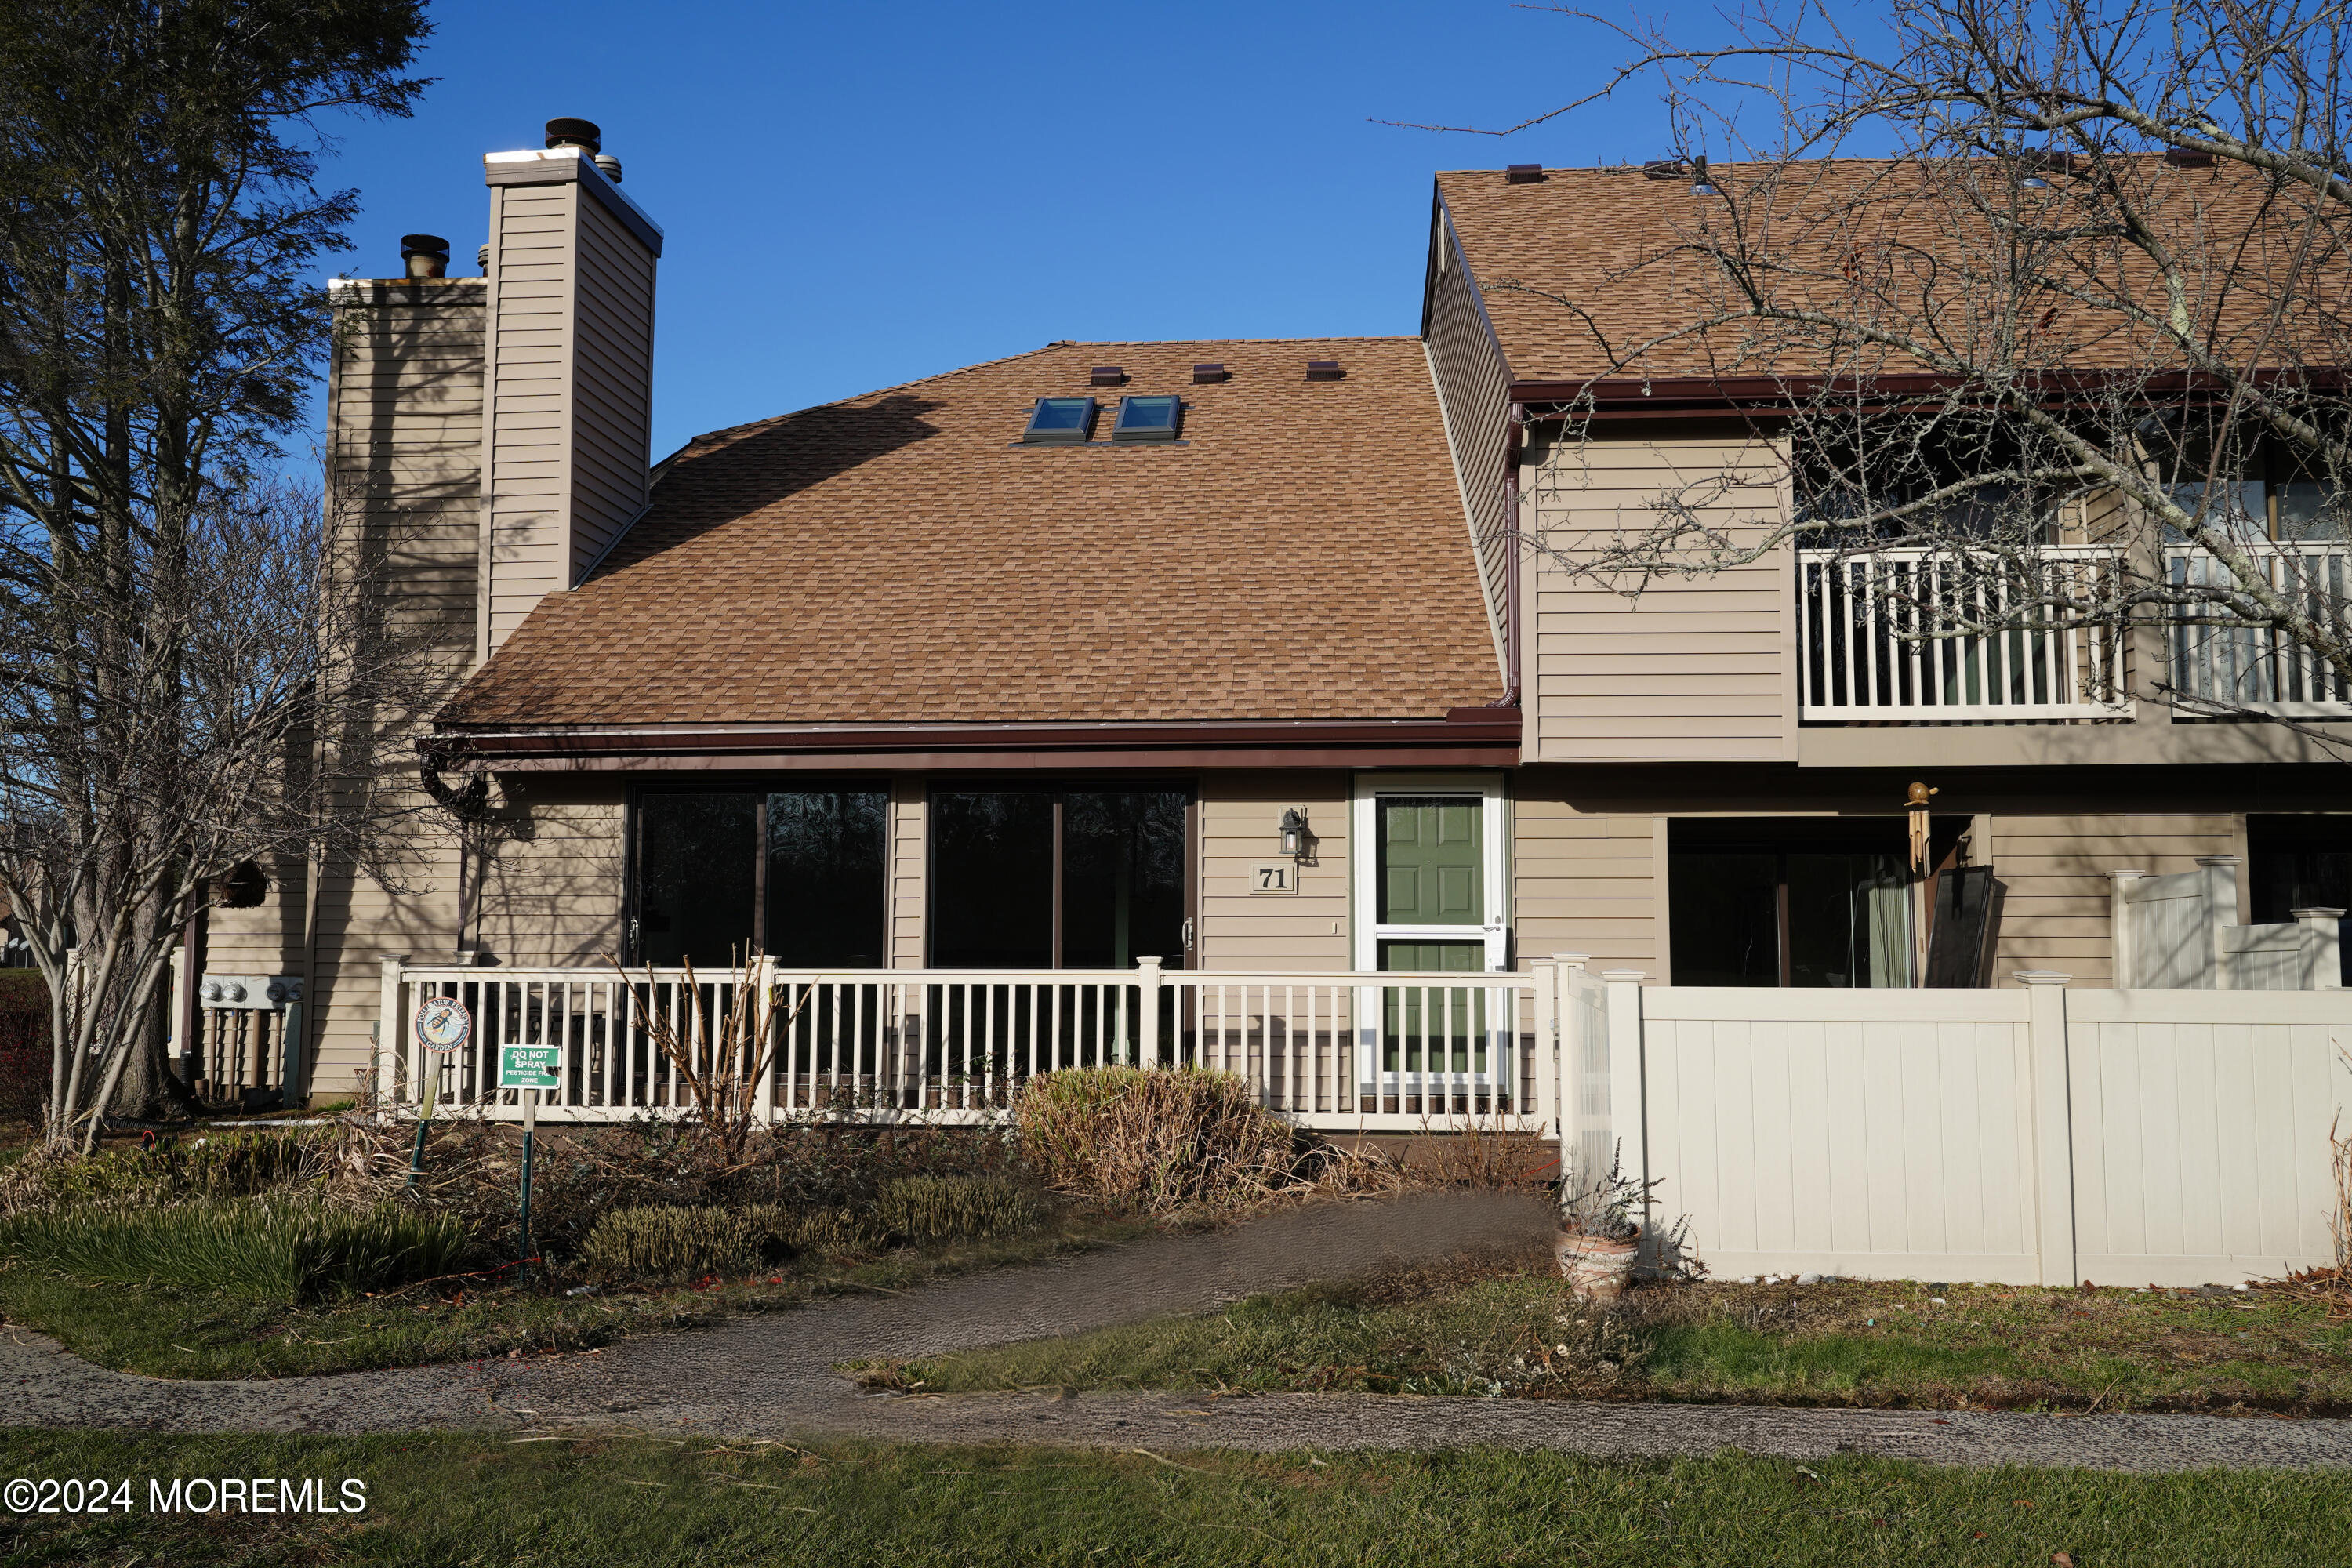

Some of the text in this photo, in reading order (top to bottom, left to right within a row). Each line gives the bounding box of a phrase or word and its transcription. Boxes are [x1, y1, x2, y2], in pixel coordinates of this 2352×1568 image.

[1260, 868, 1287, 888] 71
[417, 999, 449, 1022] POLLIATOR
[426, 1040, 452, 1051] GARDEN
[514, 1060, 546, 1069] SPRAY
